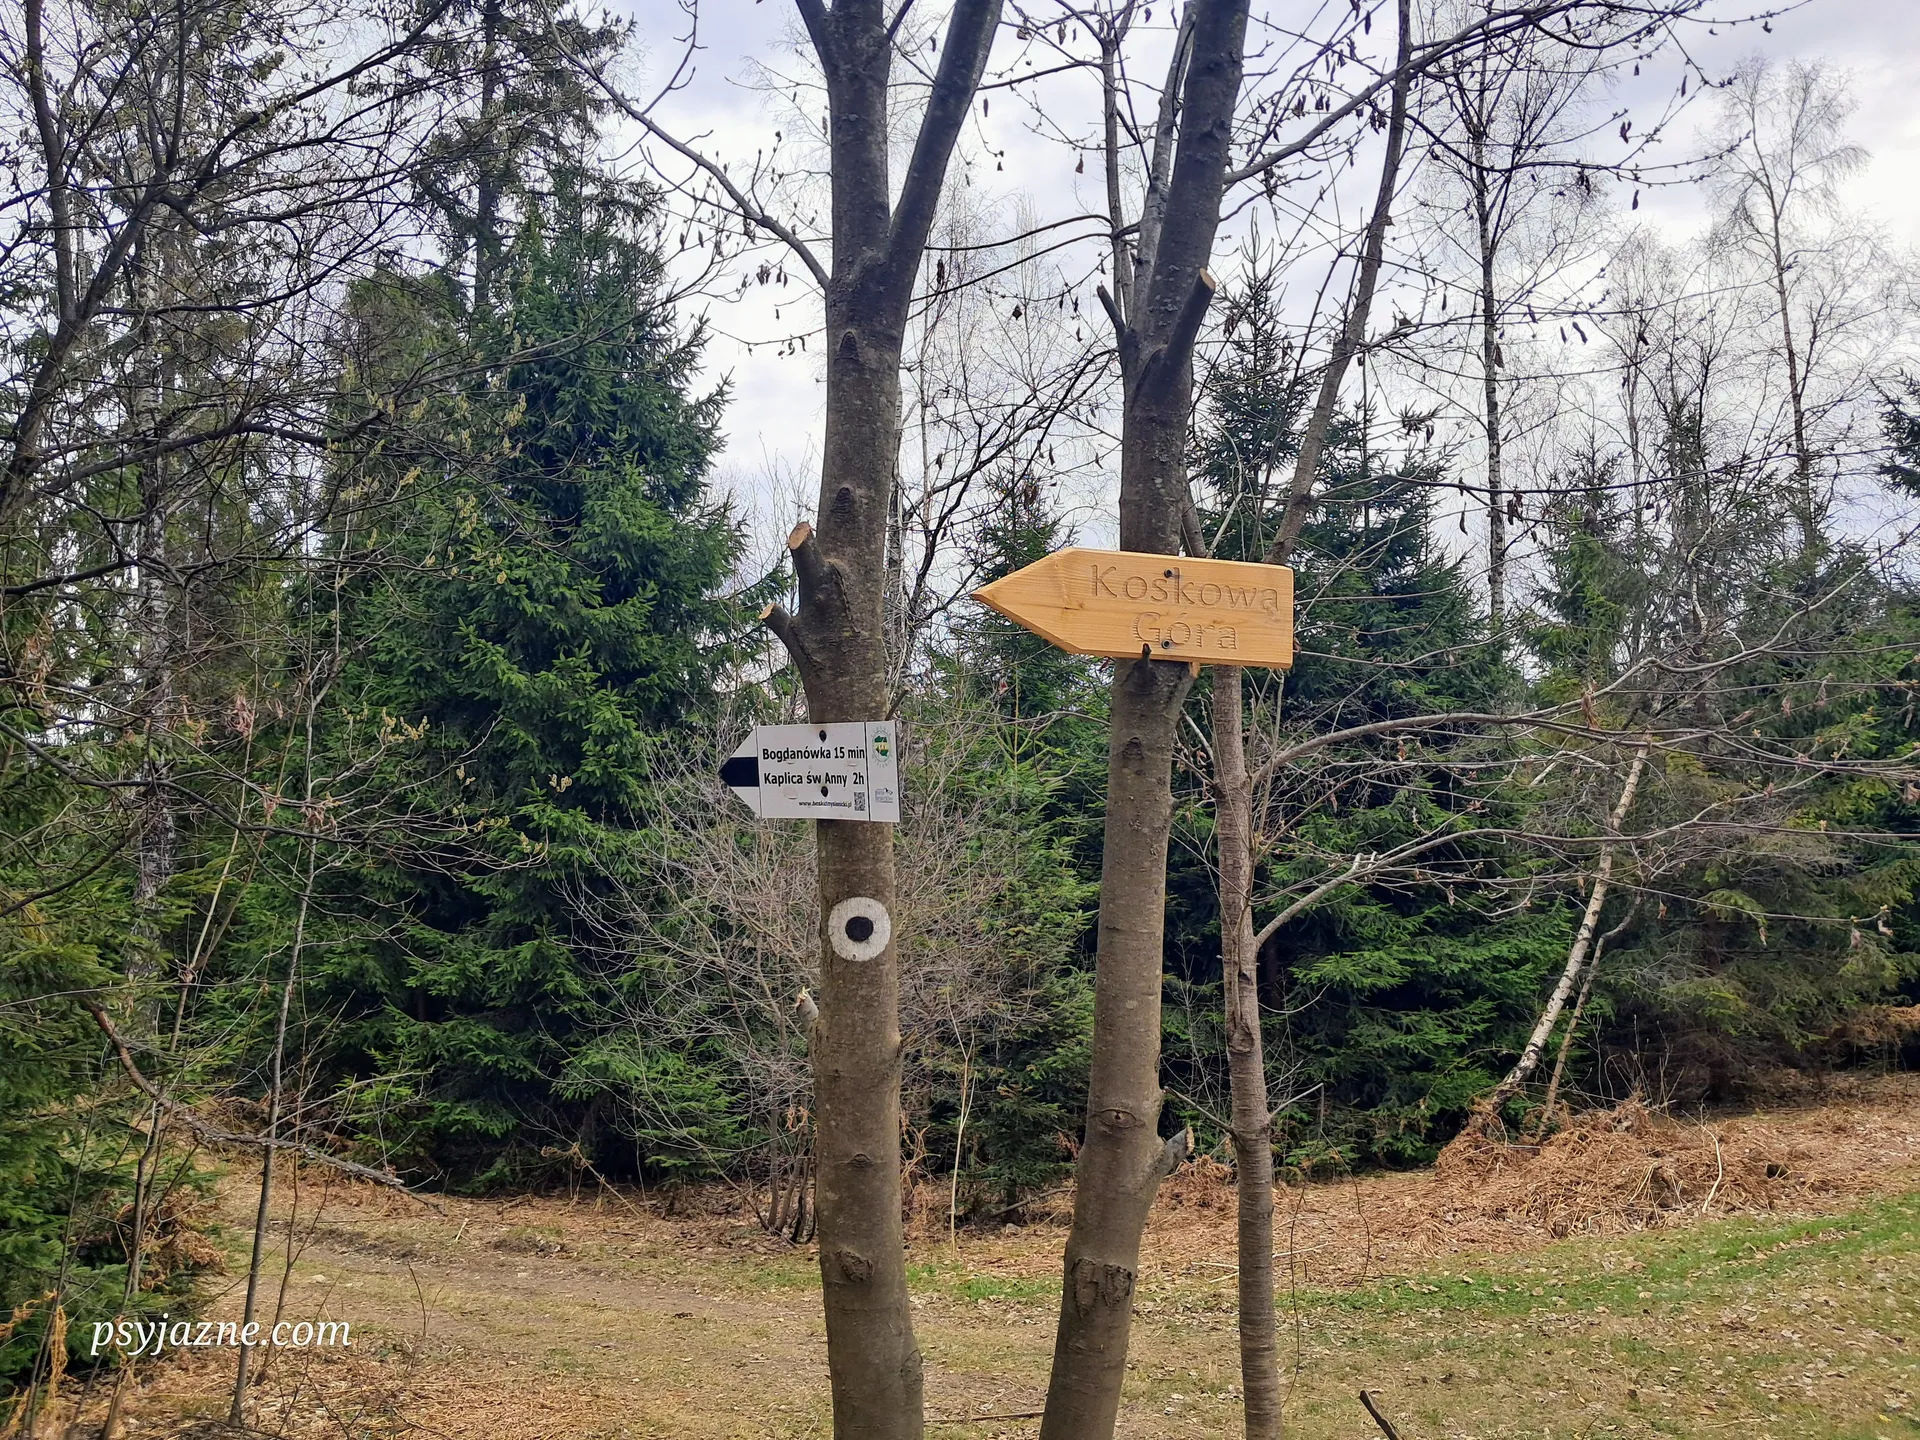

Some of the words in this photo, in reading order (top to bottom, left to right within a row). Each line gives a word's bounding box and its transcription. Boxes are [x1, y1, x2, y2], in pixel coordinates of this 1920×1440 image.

[1091, 563, 1280, 611] Koskowa
[1132, 611, 1237, 650] Góra
[762, 746, 831, 762] Bogdanówka
[834, 747, 845, 759] 15
[847, 746, 865, 759] min
[764, 772, 803, 787] Kaplica
[806, 771, 821, 784] św
[824, 772, 847, 787] Anny
[853, 772, 864, 785] 2h
